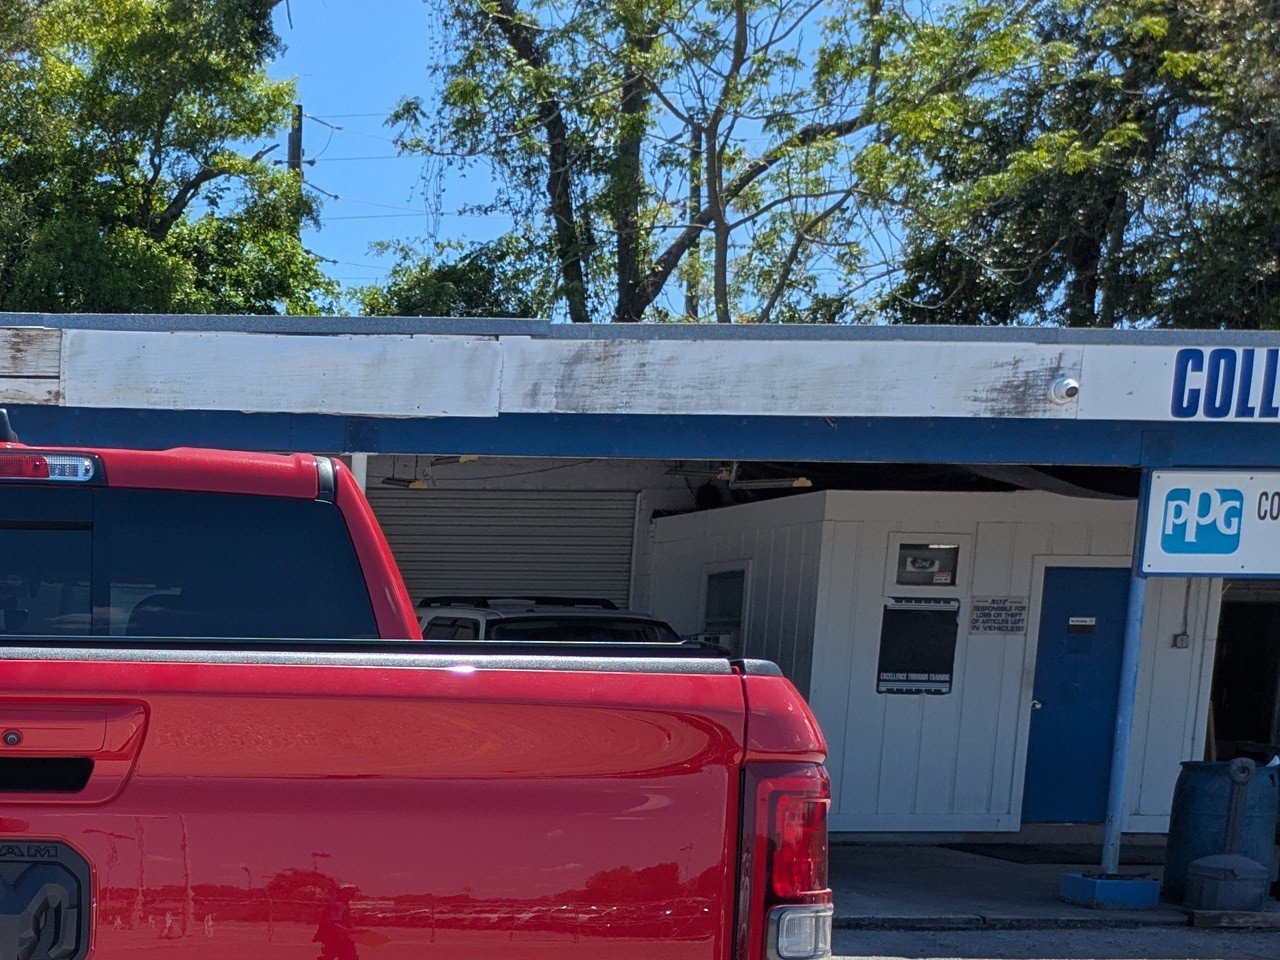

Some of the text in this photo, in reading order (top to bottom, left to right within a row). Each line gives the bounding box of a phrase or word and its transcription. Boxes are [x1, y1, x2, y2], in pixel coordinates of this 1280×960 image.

[1170, 348, 1280, 418] COLL
[1164, 488, 1240, 543] PPG
[1257, 491, 1280, 521] CO
